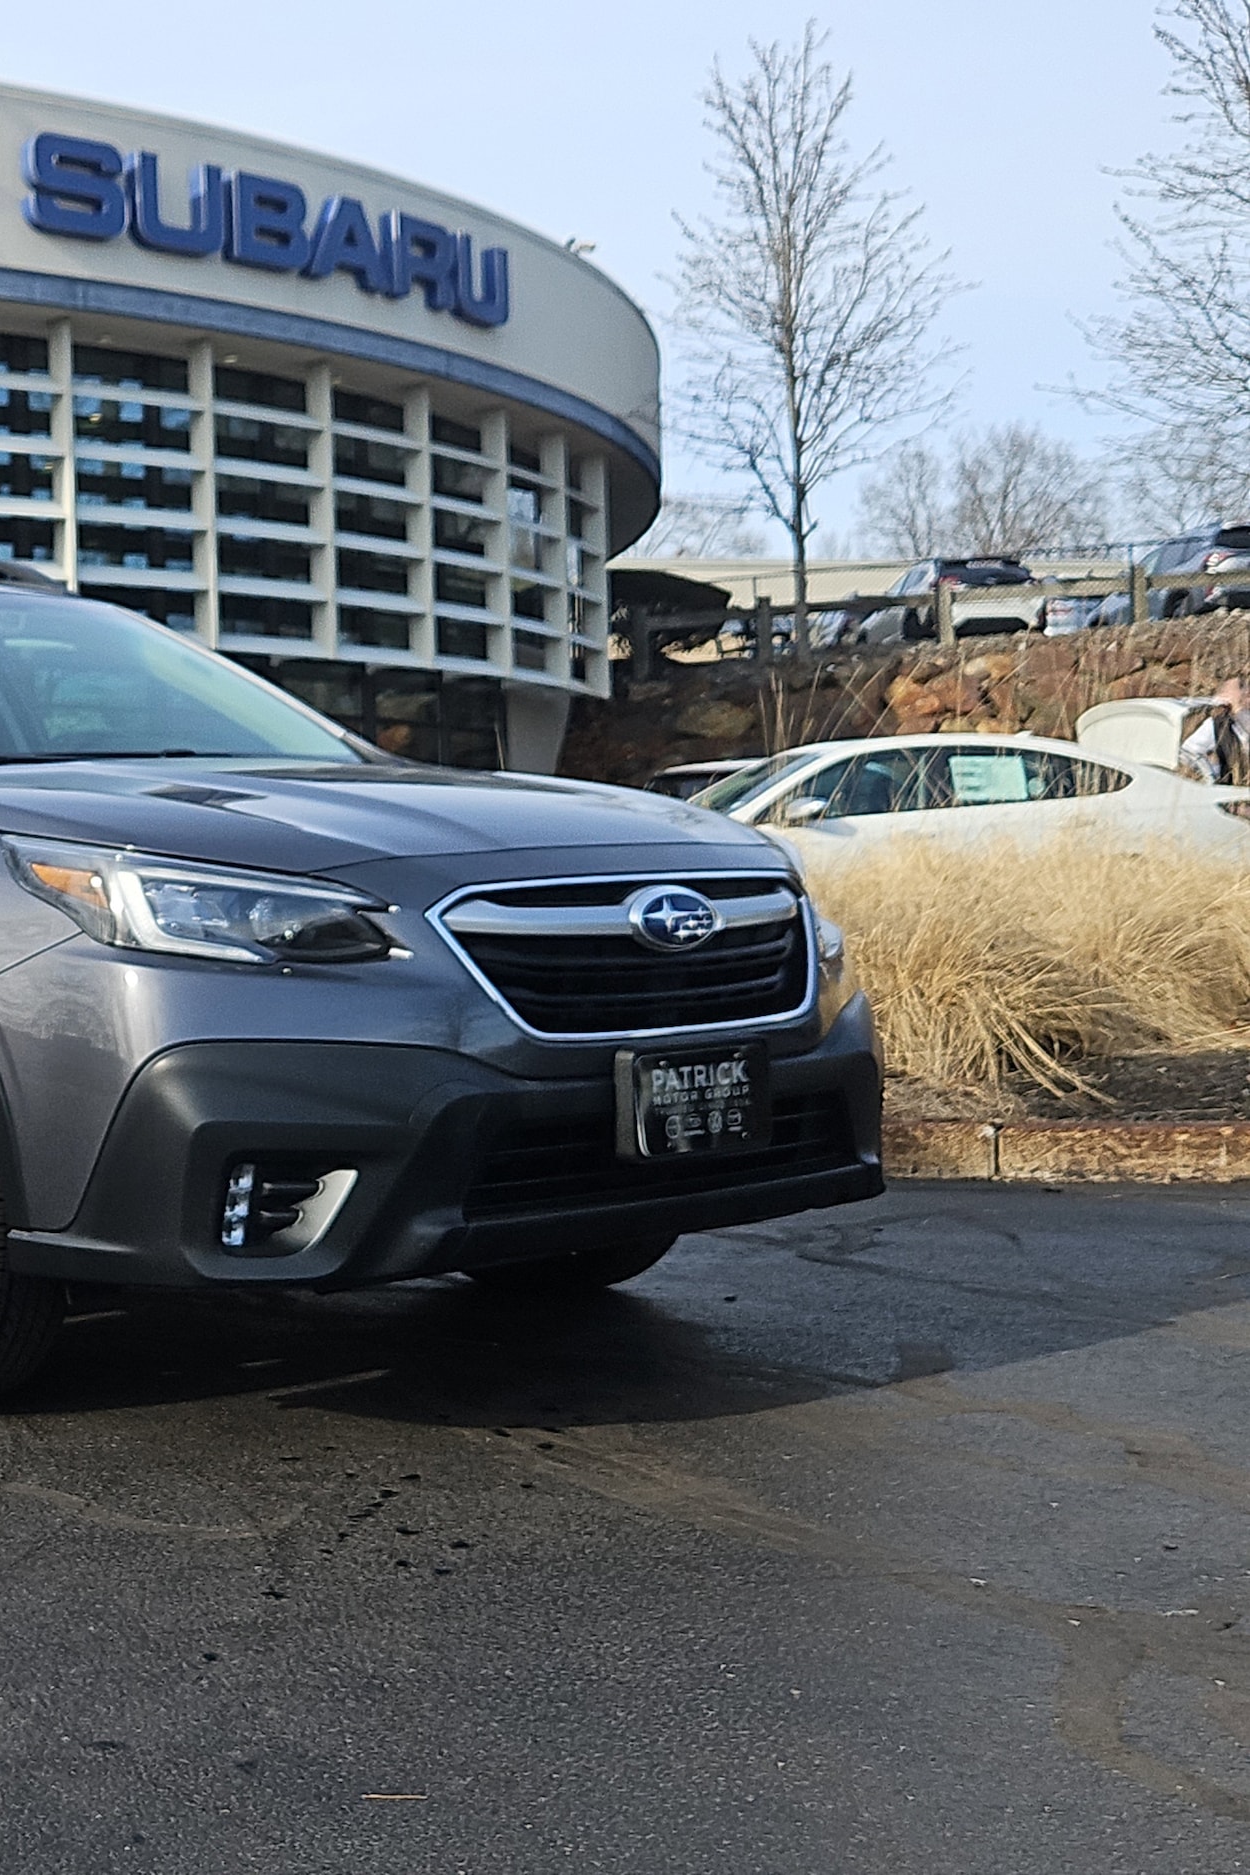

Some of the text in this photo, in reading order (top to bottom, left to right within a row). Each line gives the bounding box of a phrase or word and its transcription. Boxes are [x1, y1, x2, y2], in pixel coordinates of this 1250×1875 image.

[21, 131, 509, 328] SUBARU
[652, 1060, 749, 1092] PATRICK
[653, 1086, 750, 1106] MOTOR GROUP
